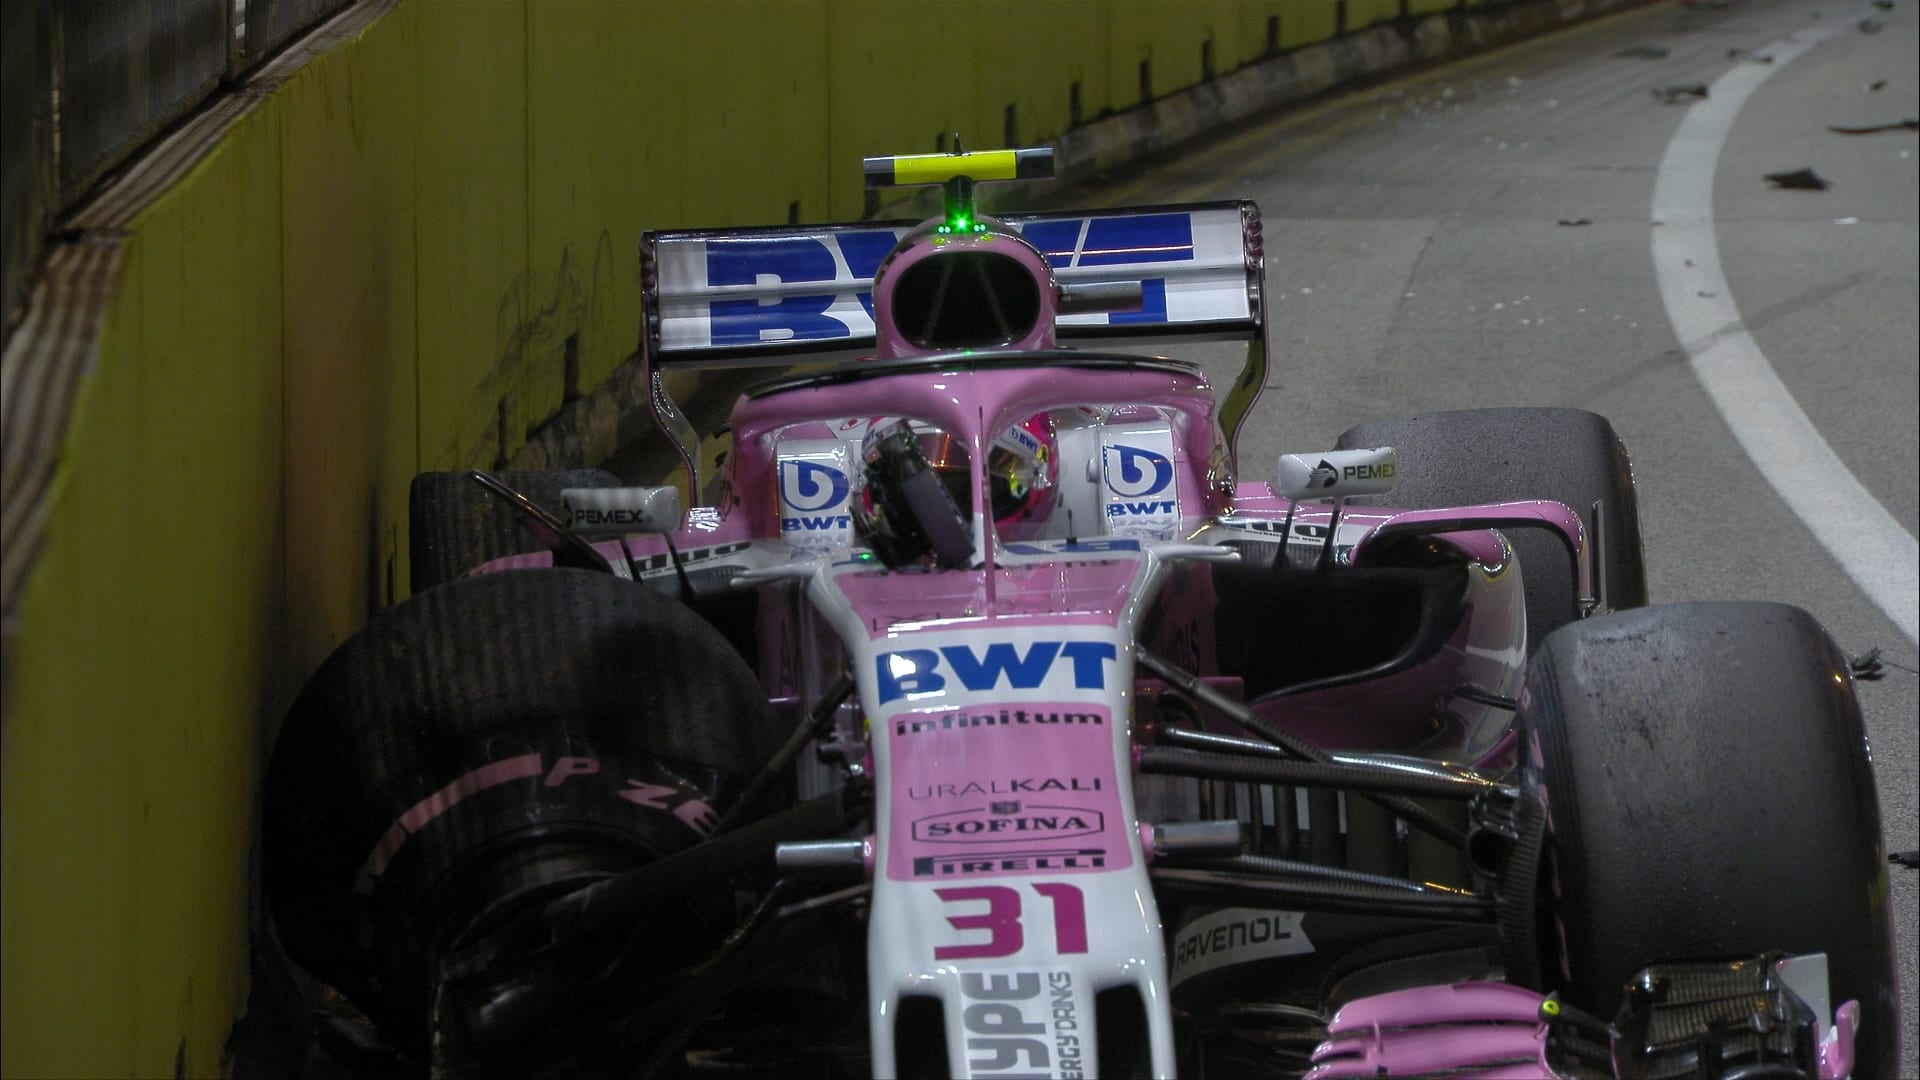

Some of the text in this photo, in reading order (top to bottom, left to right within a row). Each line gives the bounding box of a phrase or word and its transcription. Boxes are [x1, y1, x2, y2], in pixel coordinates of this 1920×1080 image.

[576, 509, 644, 524] PEMEX
[1107, 501, 1175, 517] BWT
[782, 515, 851, 531] BWT
[876, 641, 1117, 706] BWT
[896, 710, 1103, 736] infinitum
[908, 778, 1102, 800] URALKALI
[928, 816, 1091, 837] SOFINA
[913, 849, 1107, 876] PIRELLI
[934, 883, 1089, 960] 31
[1176, 915, 1292, 967] RAVENOL
[960, 972, 1053, 1080] YPE
[1048, 971, 1084, 1080] ERGY DRINKS
